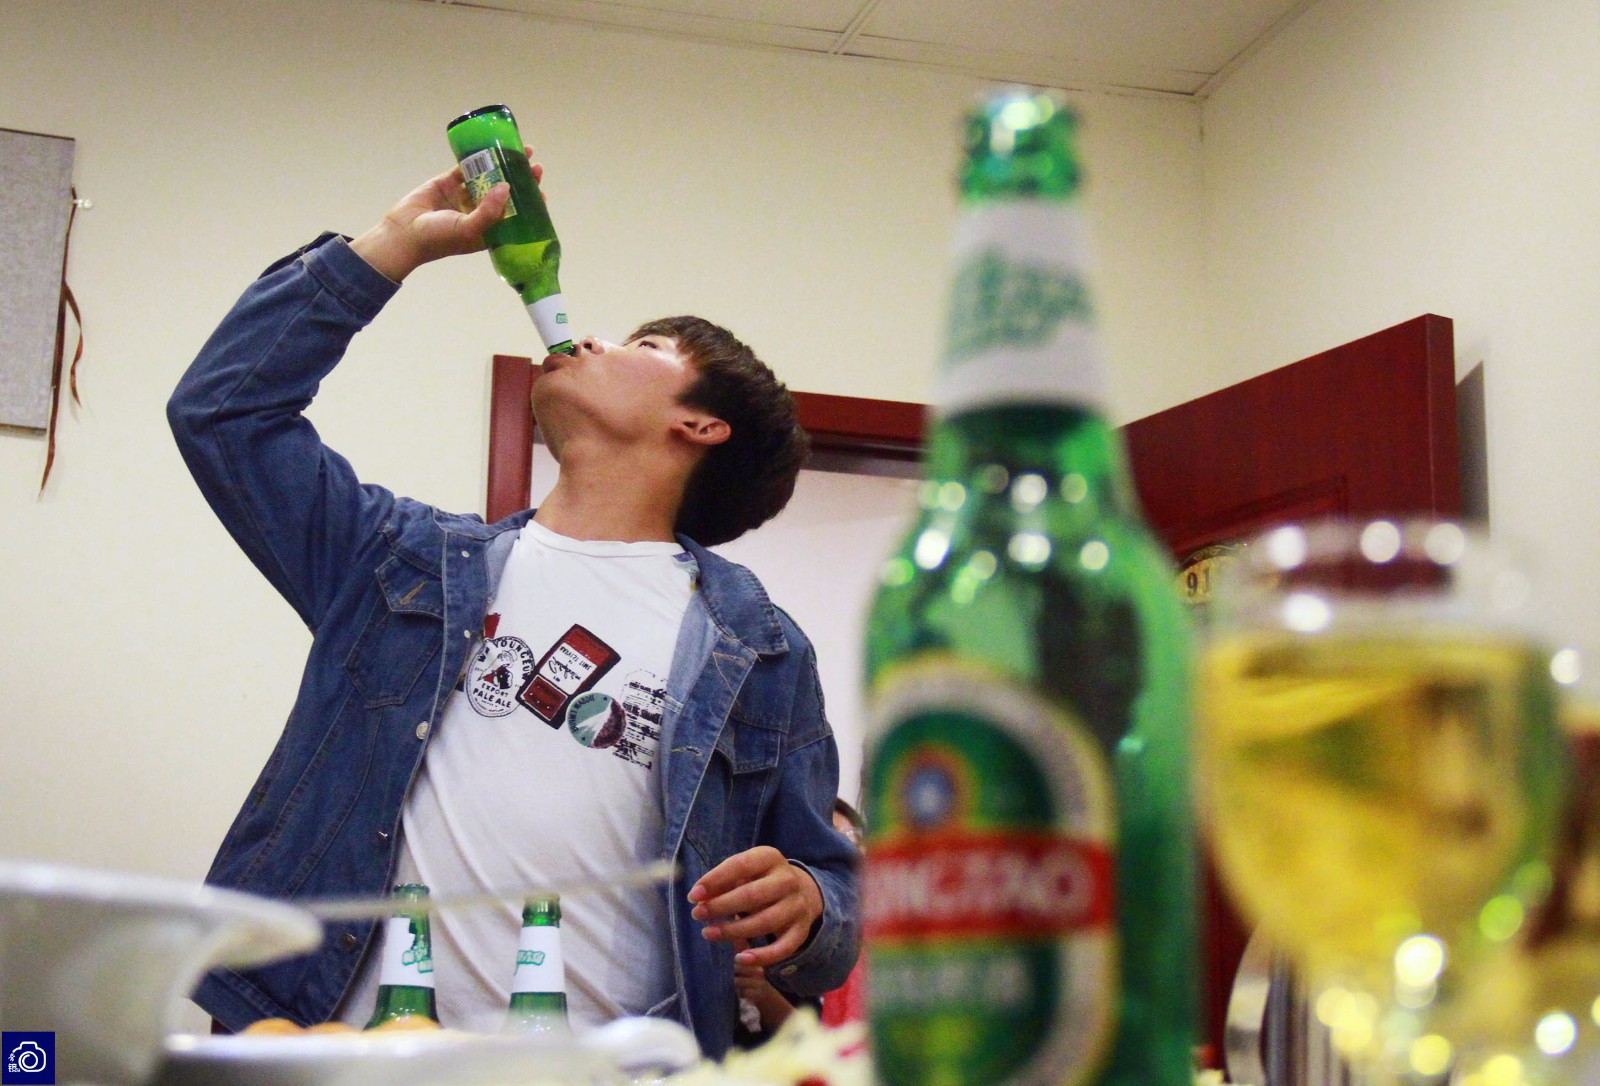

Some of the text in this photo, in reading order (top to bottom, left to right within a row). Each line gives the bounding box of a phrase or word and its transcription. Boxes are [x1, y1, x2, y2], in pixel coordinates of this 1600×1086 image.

[472, 687, 495, 702] PALE
[495, 698, 512, 709] ALE
[481, 682, 509, 698] EXPORT
